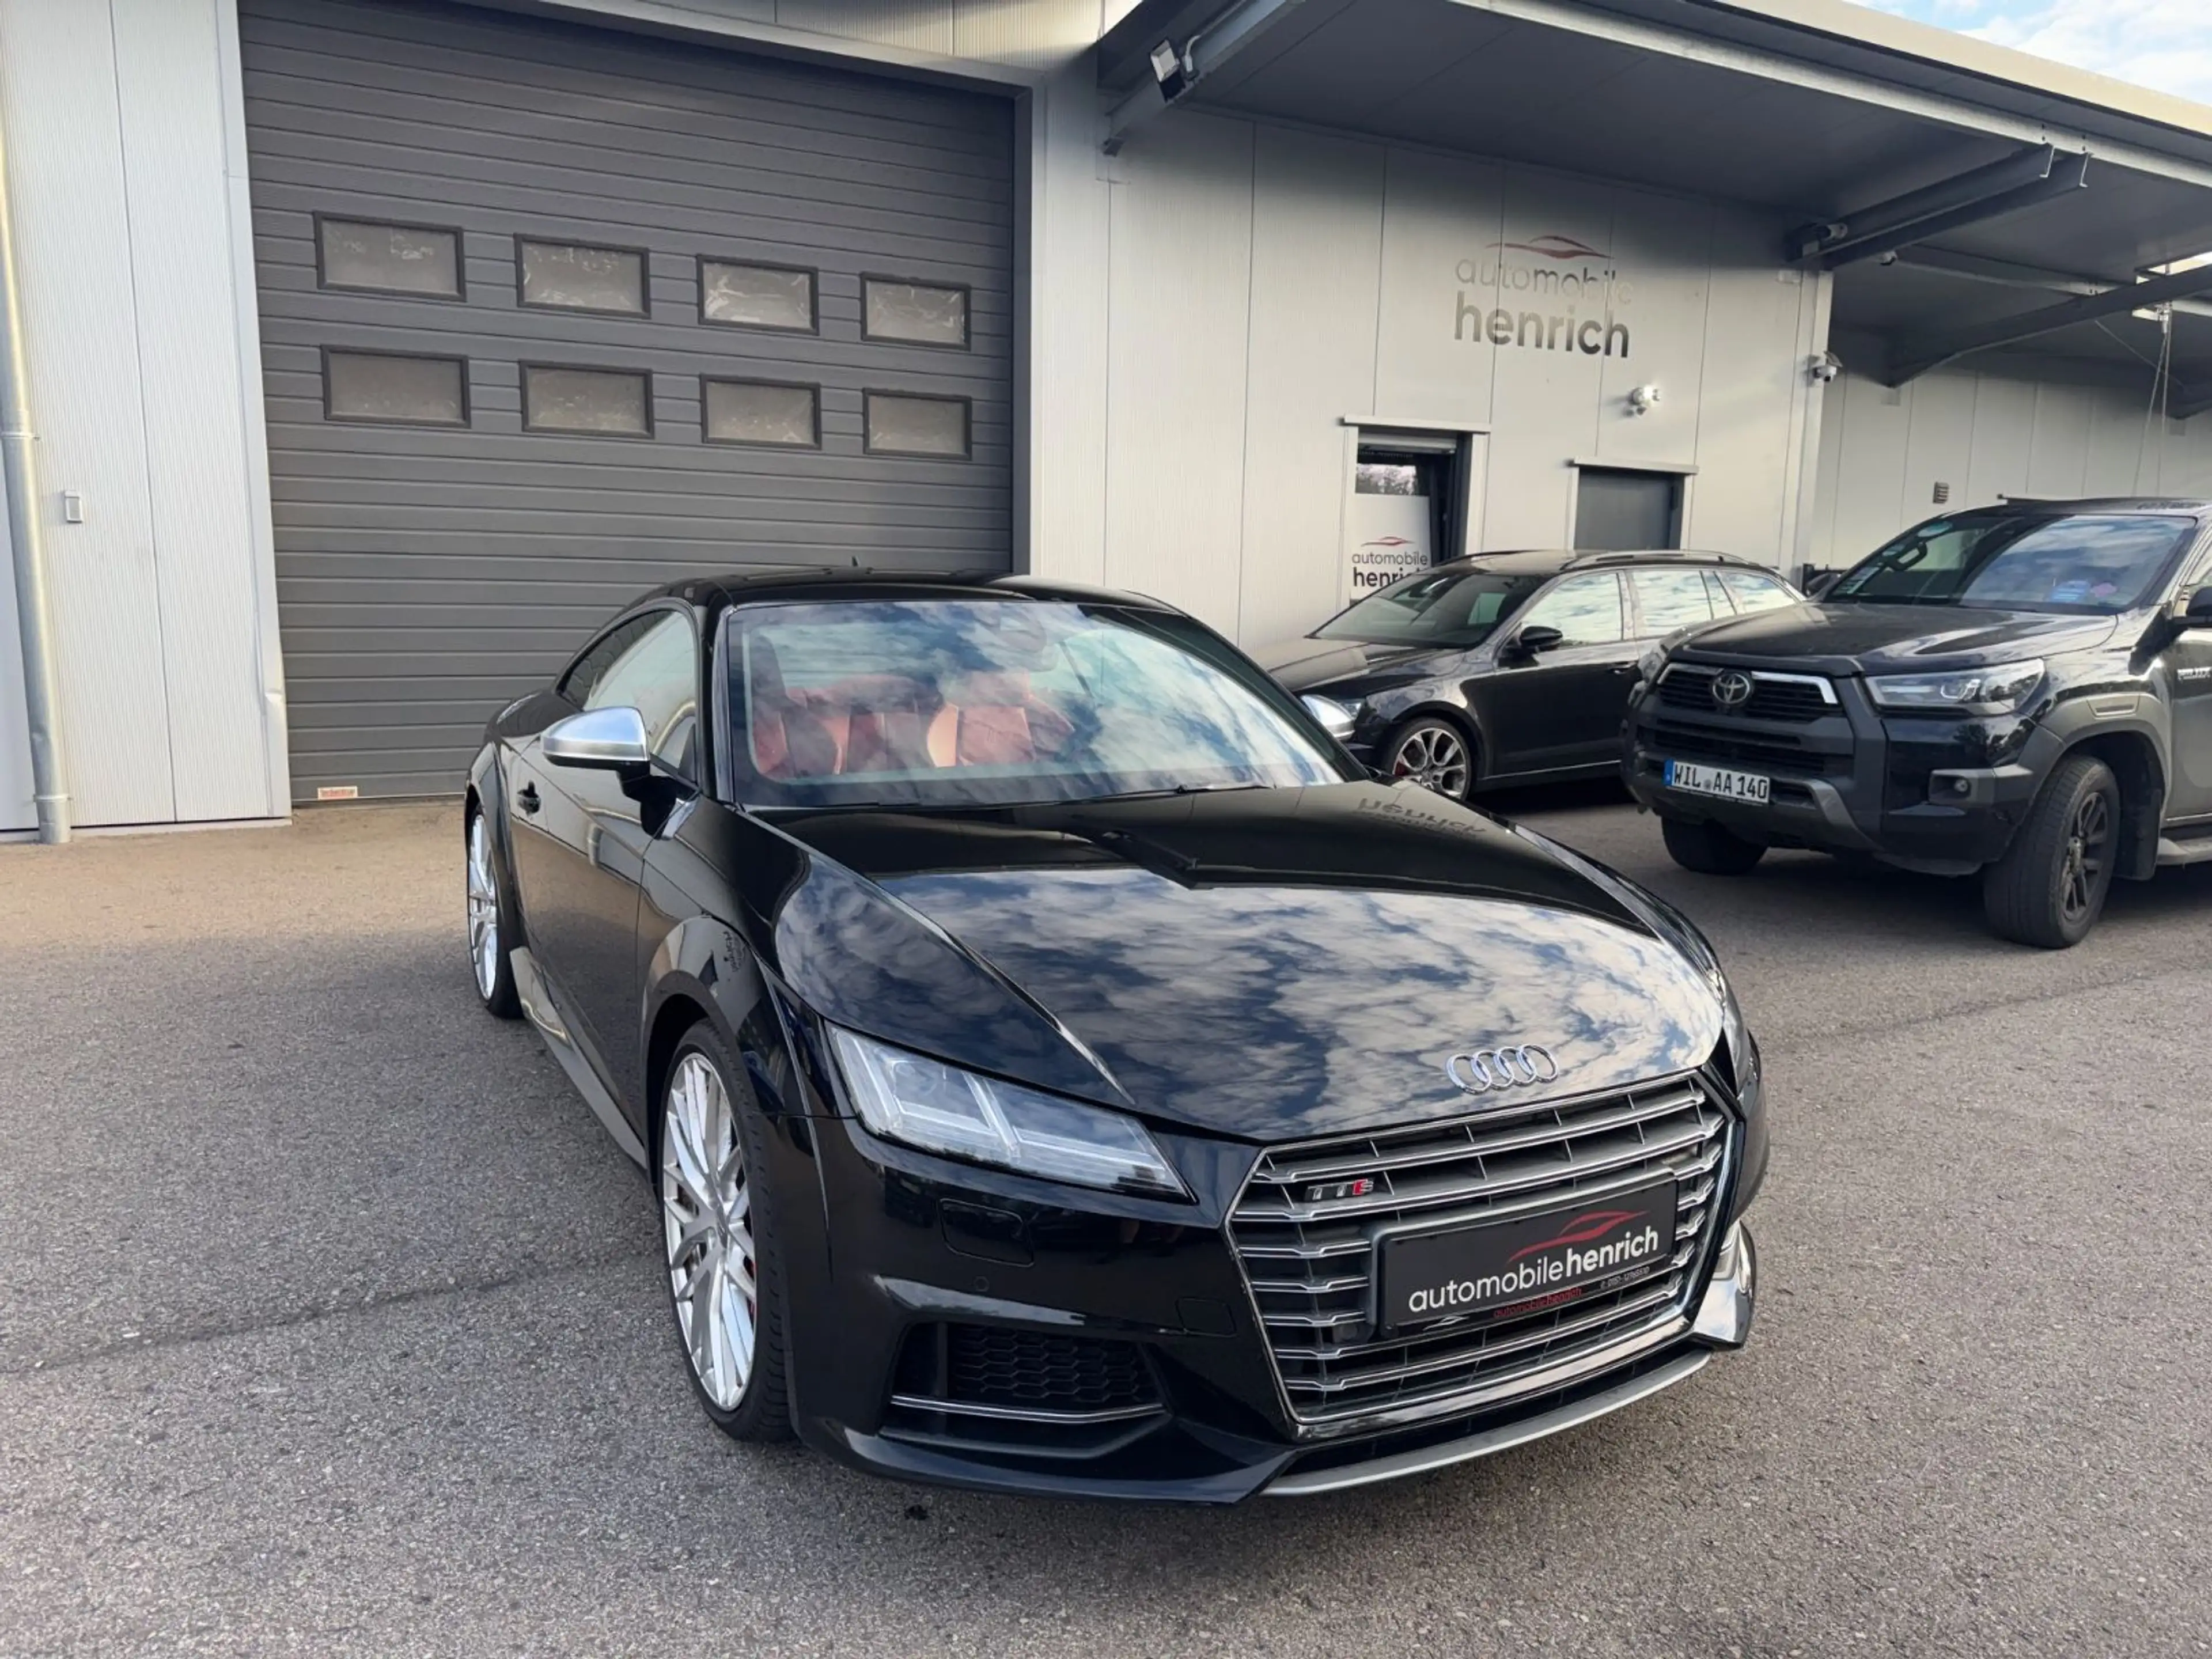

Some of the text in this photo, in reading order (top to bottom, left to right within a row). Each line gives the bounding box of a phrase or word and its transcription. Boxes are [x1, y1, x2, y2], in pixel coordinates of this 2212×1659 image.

[1454, 290, 1630, 358] henrich
[1352, 551, 1428, 565] automobile
[1674, 764, 1767, 798] WIL AA 140
